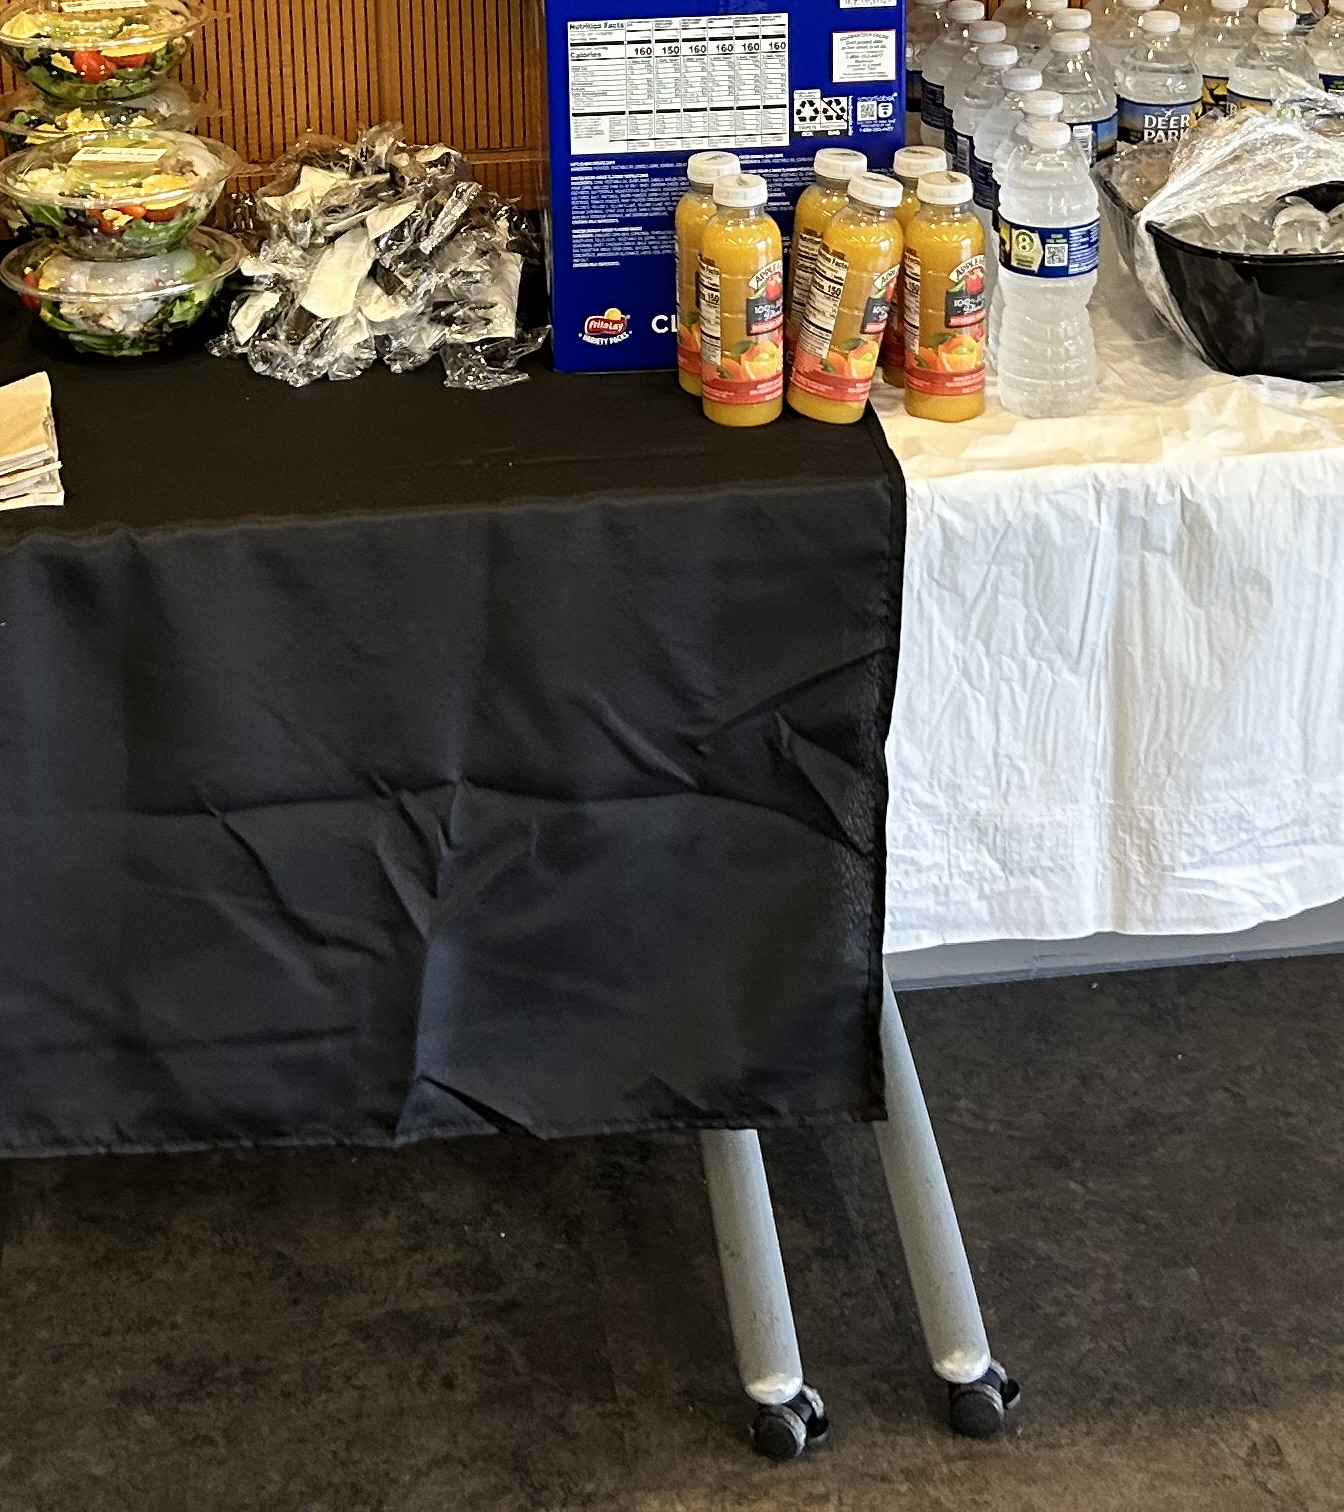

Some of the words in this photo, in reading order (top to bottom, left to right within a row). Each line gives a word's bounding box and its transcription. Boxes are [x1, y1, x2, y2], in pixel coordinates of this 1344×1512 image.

[634, 47, 652, 56] 160
[688, 45, 707, 54] 160
[715, 44, 734, 53] 160
[741, 42, 760, 52] 160
[768, 41, 787, 51] 160
[1144, 114, 1190, 129] DEER
[651, 314, 678, 334] CL
